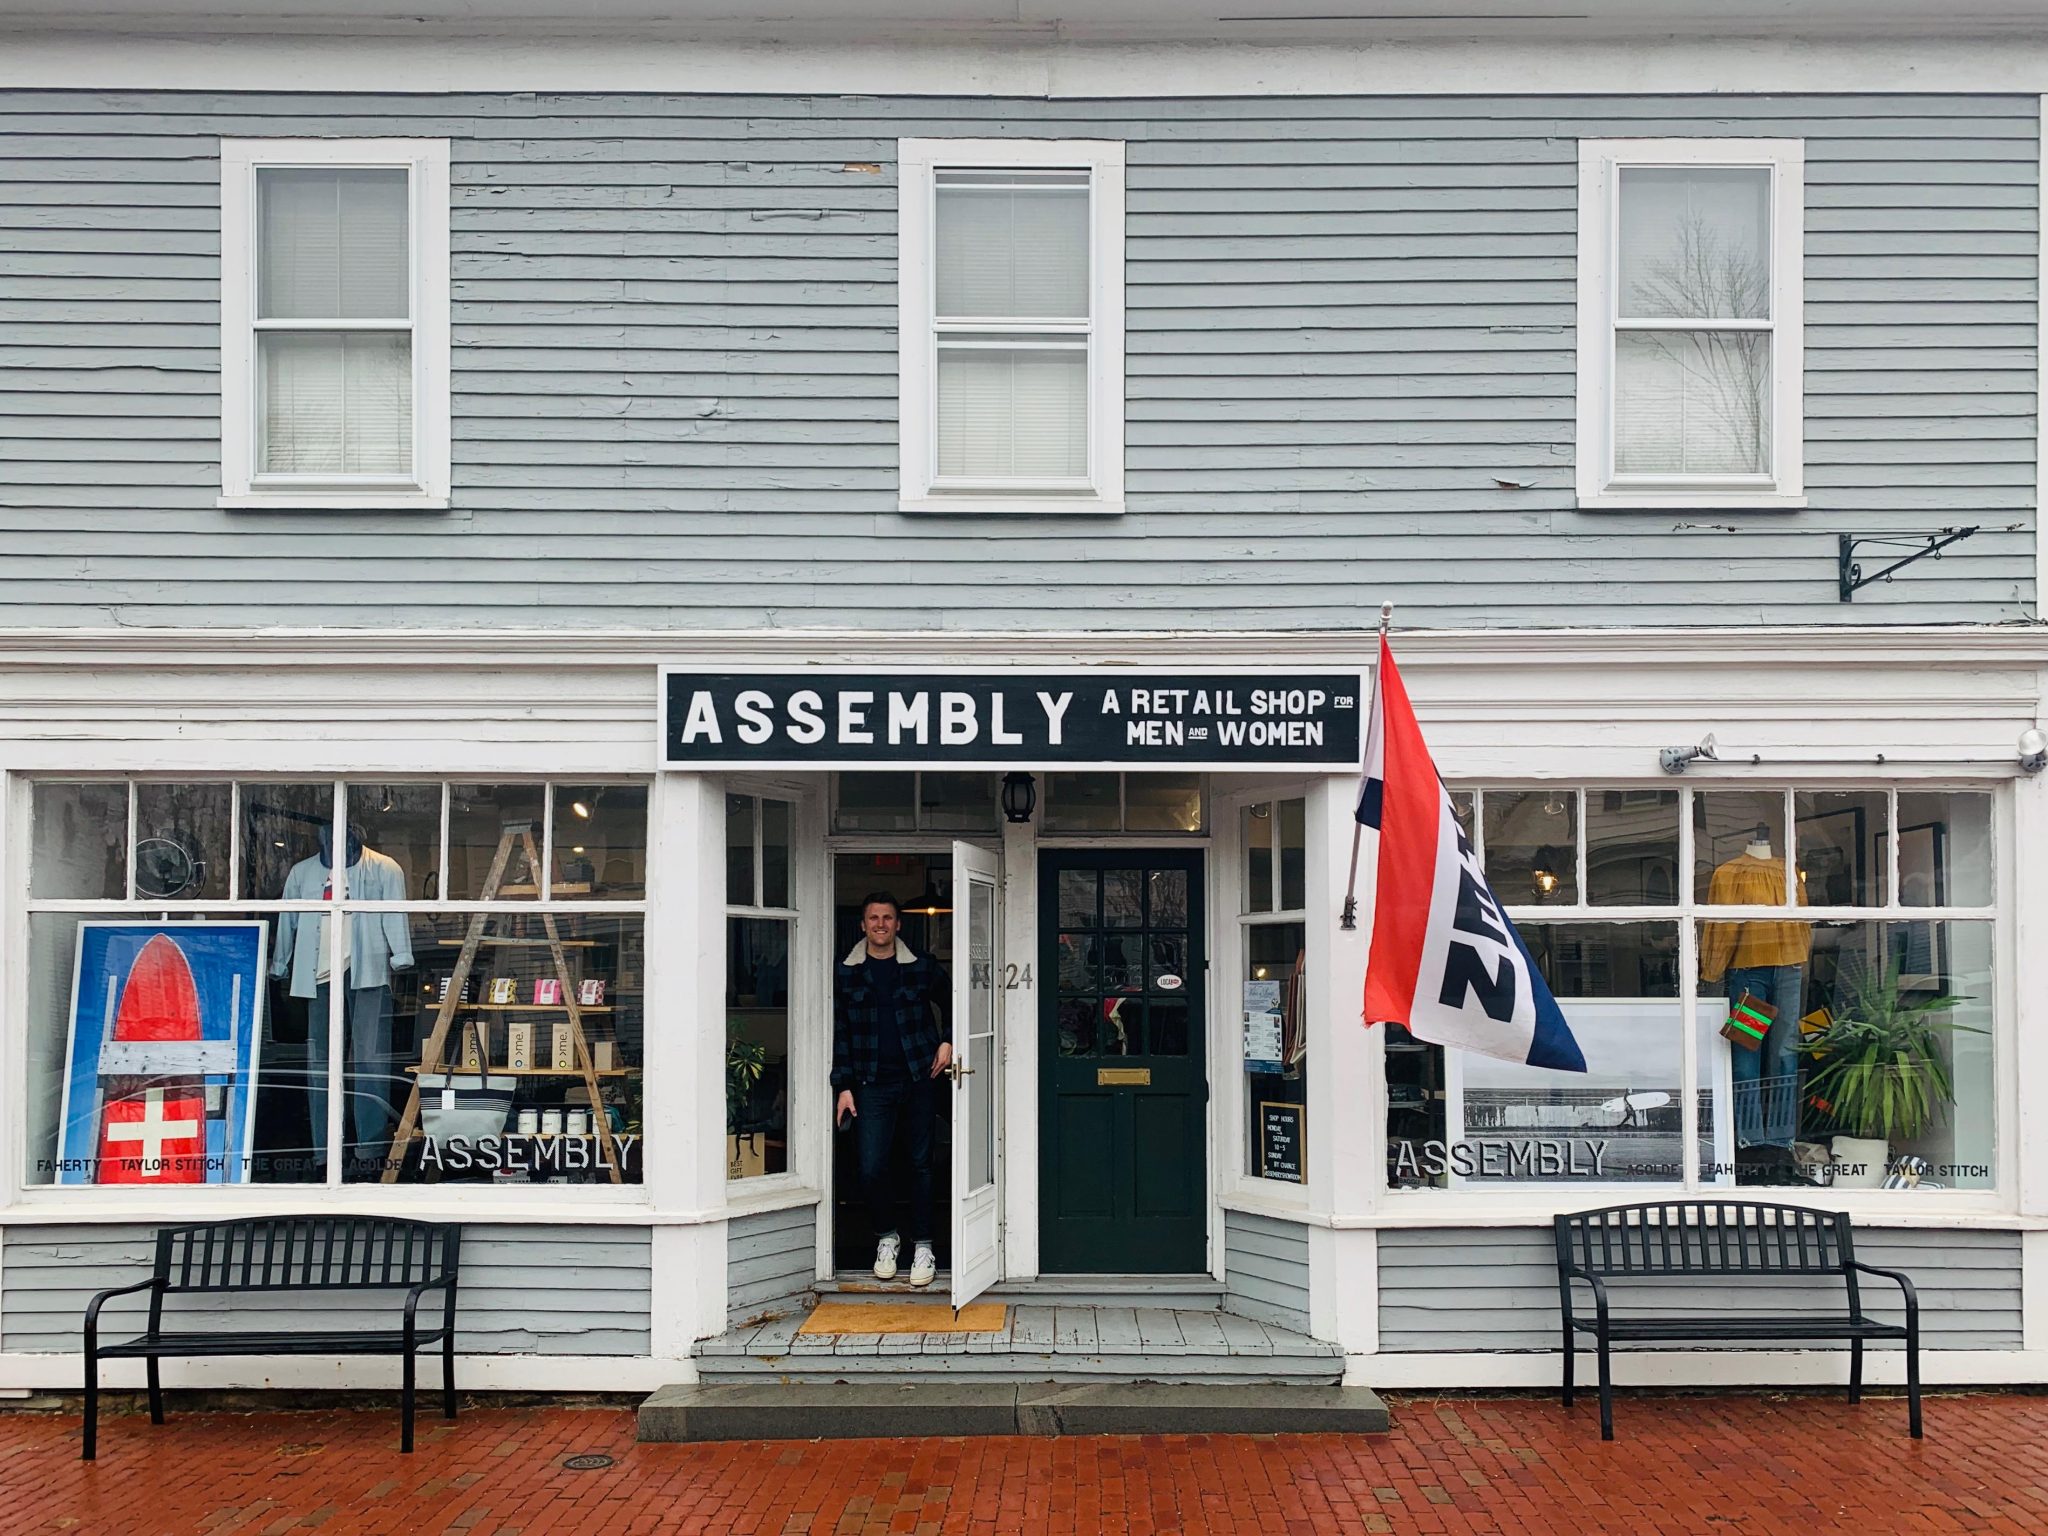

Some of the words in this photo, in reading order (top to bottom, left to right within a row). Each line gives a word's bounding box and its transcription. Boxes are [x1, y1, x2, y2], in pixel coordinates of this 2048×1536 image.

[1102, 690, 1120, 713] A
[1132, 689, 1241, 714] RETAIL
[1251, 690, 1325, 714] SHOP
[1334, 697, 1353, 708] FOR
[682, 690, 1073, 744] ASSEMBLY
[1127, 721, 1183, 745] MEN
[1188, 728, 1207, 739] AND
[1217, 721, 1323, 745] WOMEN
[1006, 963, 1033, 990] 24
[419, 1133, 636, 1171] ASSEMBLY
[1395, 1139, 1610, 1177] ASSEMBLY
[37, 1159, 102, 1171] FAHERTY
[121, 1159, 170, 1171] TAYLOR
[176, 1158, 224, 1171] STITCH
[242, 1158, 270, 1171] THE
[273, 1158, 320, 1171] GREAT
[350, 1158, 402, 1171] AGOLDE
[1626, 1163, 1679, 1176] AGOLDE
[1707, 1163, 1771, 1177] FAHERTY
[1822, 1163, 1868, 1176] GREAT
[1884, 1164, 1934, 1177] TAYLOR
[1939, 1165, 1988, 1177] STITCH
